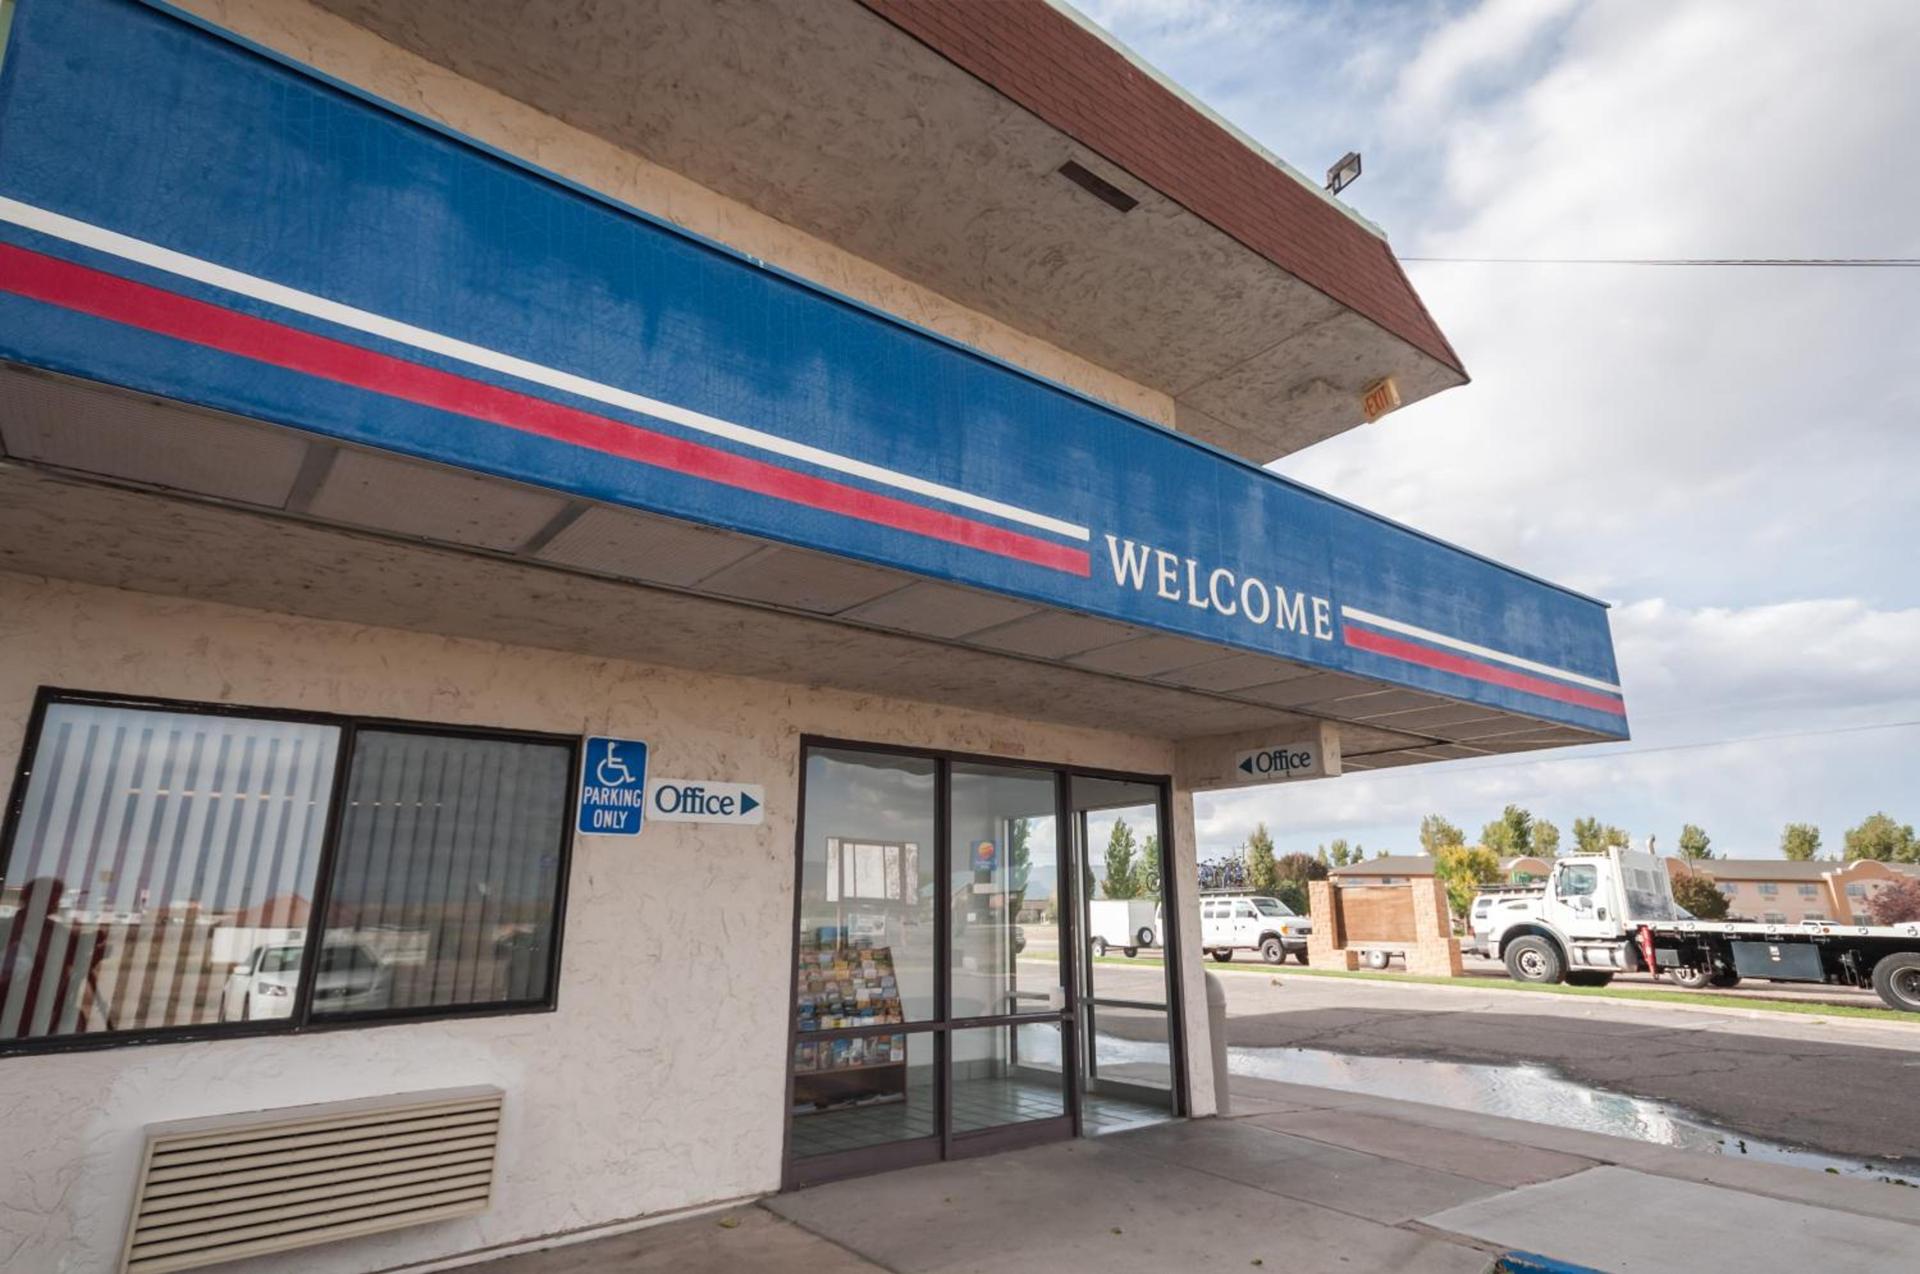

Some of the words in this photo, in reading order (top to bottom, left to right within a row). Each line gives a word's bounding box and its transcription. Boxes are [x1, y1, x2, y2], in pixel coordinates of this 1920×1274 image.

[1365, 385, 1389, 417] EXIT
[1104, 534, 1334, 641] WELCOME
[1256, 749, 1311, 773] Office
[583, 786, 642, 808] PARKING
[655, 785, 735, 815] Office
[593, 809, 628, 829] ONLY
